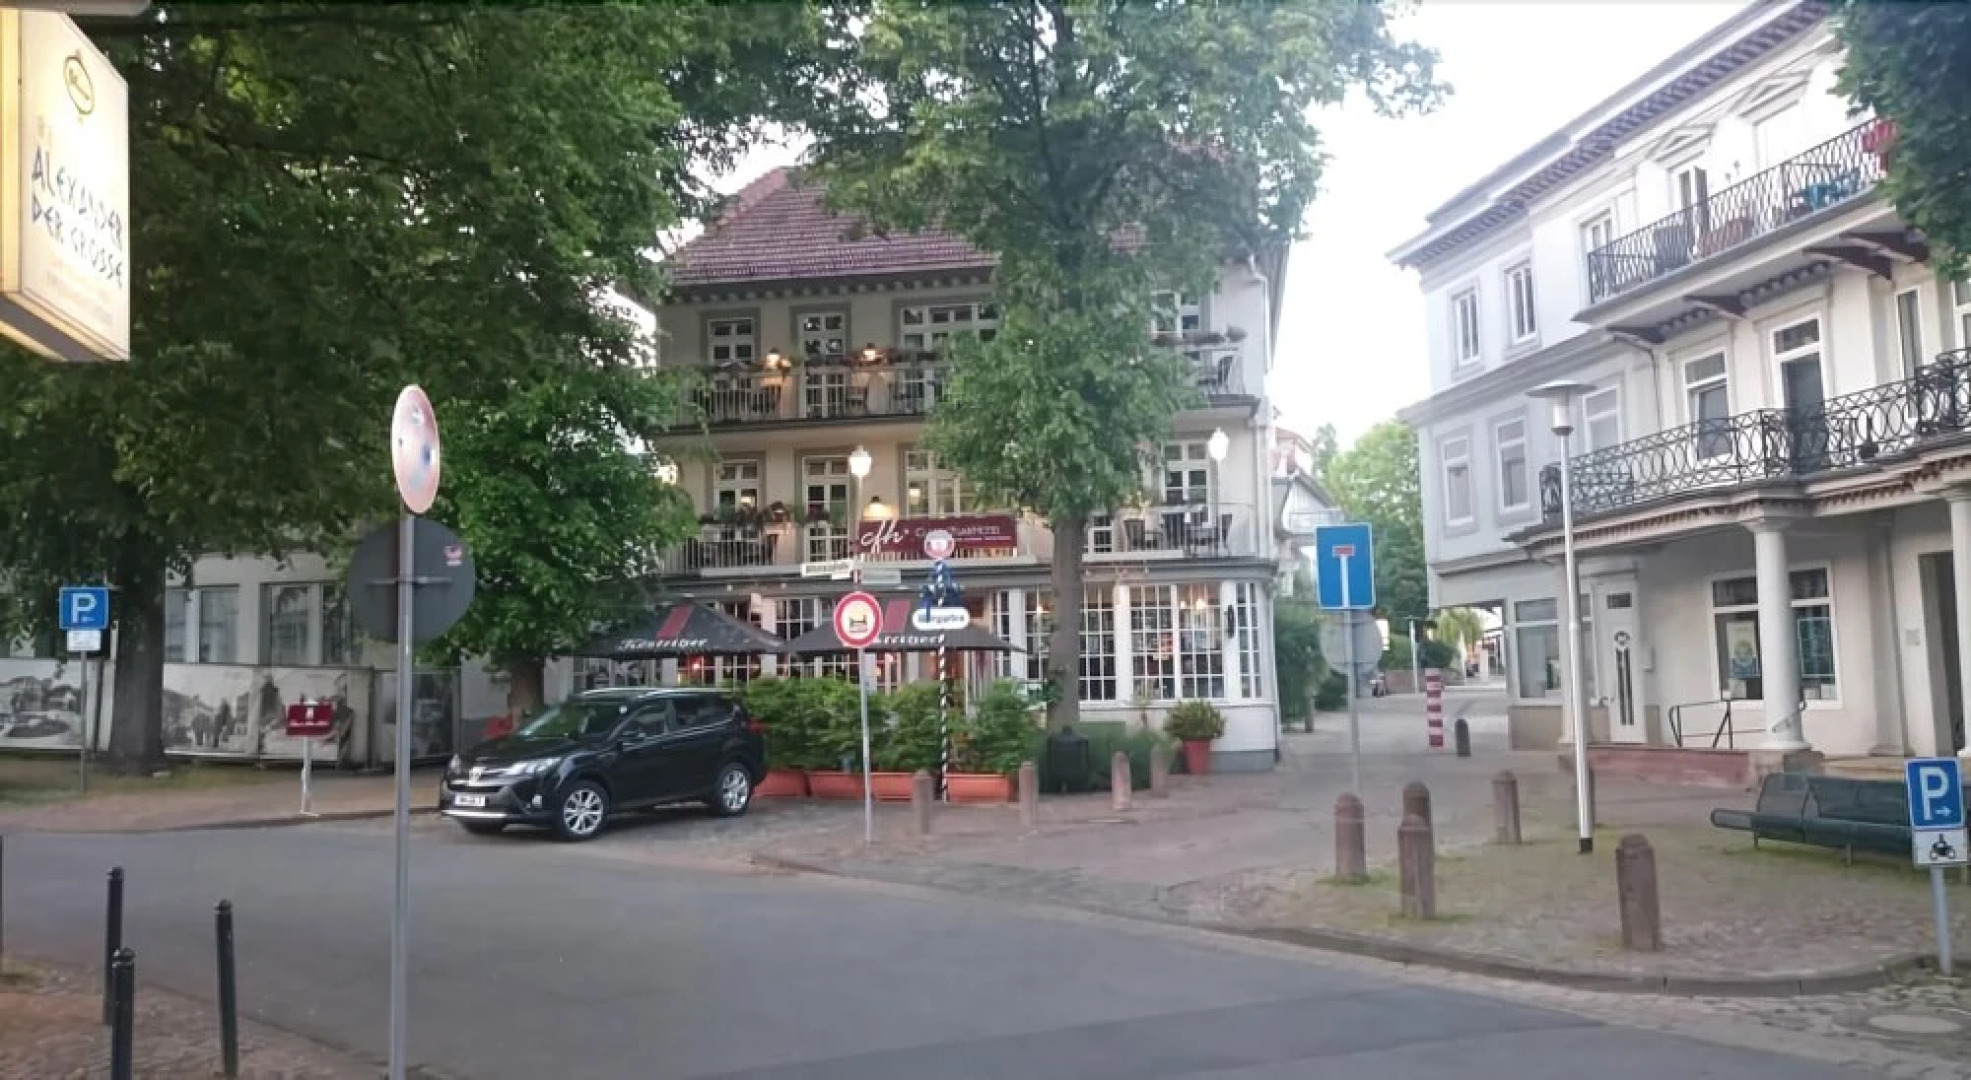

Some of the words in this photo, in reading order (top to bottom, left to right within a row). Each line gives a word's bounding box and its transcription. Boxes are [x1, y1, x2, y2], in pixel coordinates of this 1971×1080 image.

[31, 144, 123, 252] ALEXANDER
[31, 190, 64, 245] DER
[72, 593, 97, 623] P
[1919, 766, 1950, 821] P
